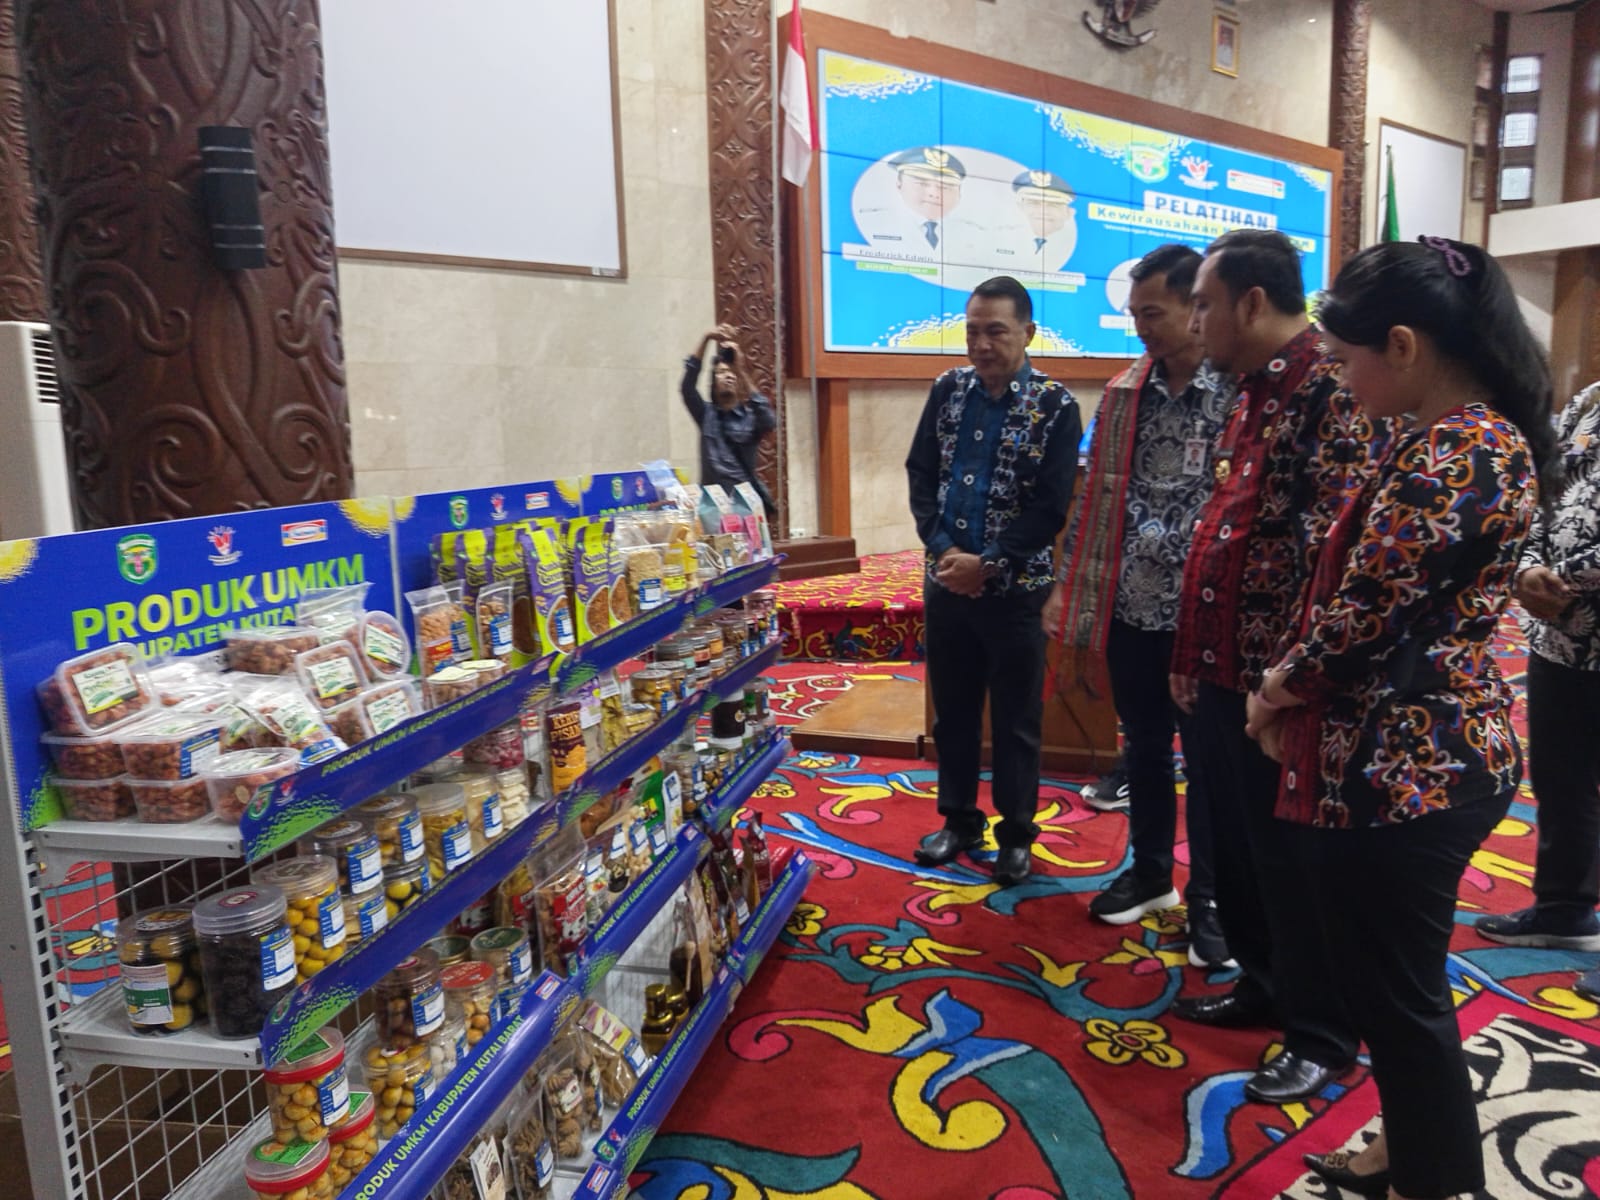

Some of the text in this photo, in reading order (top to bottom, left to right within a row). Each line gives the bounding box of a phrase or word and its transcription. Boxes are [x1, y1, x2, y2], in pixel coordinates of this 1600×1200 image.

[1096, 206, 1219, 236] Kewirausahaan
[1155, 196, 1269, 229] PELATIHAN
[71, 553, 365, 651] PRODUK UMKM
[354, 1157, 401, 1200] RODUK
[393, 1123, 431, 1161] UMKM
[425, 1068, 481, 1127] KABUPATEN
[475, 1041, 502, 1071] KUTAI
[497, 1014, 526, 1045] BARAT
